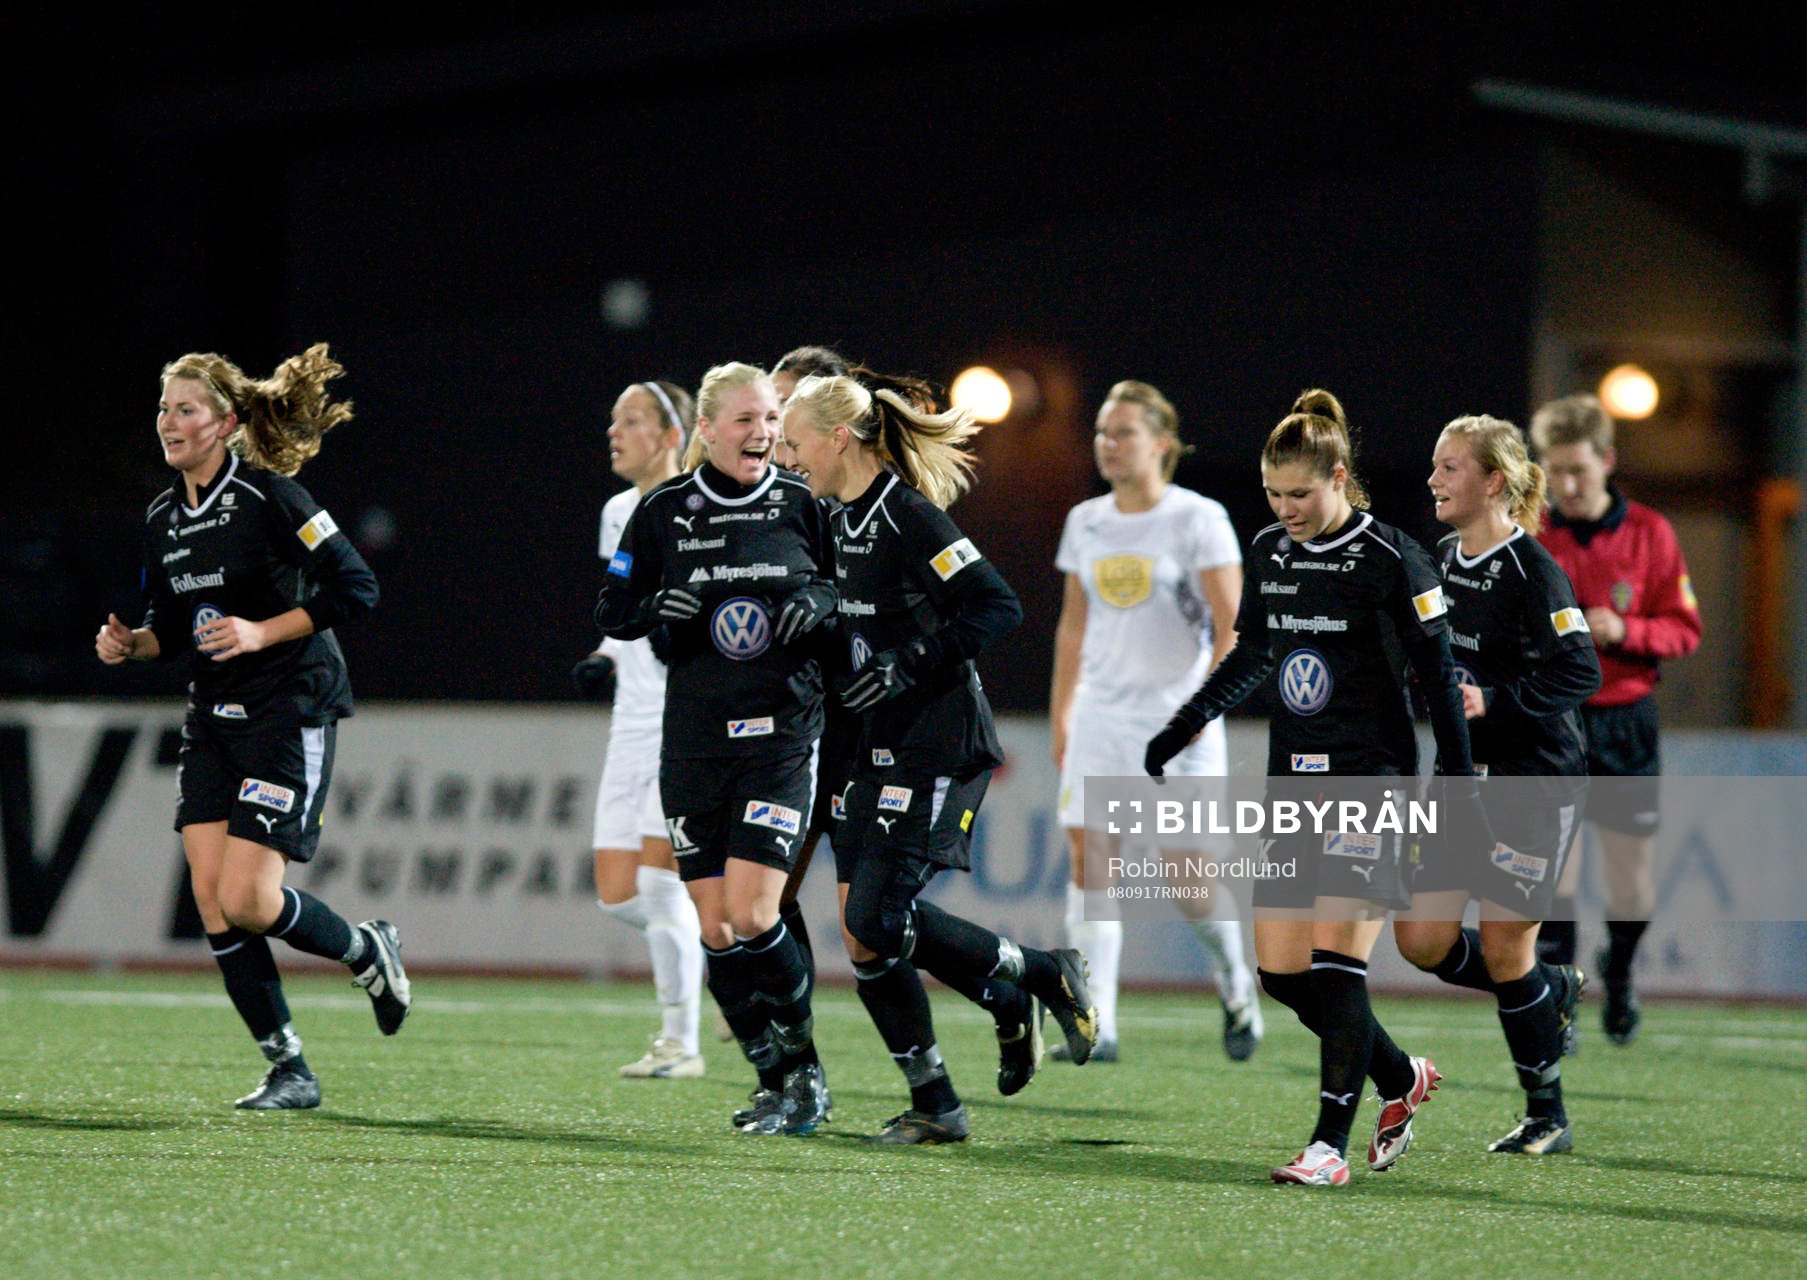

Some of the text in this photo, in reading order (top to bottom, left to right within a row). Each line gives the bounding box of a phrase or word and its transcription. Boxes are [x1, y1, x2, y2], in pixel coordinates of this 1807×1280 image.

[678, 538, 725, 552] Folksam
[712, 563, 788, 582] Myresjöhus
[170, 573, 224, 594] Folksam
[1261, 582, 1297, 594] Folksam
[1281, 614, 1348, 634] Myresjöhus
[1449, 626, 1479, 651] lksam
[260, 783, 289, 798] INTER
[883, 788, 907, 800] NTER
[258, 793, 288, 808] SPORT
[770, 805, 798, 820] INTER
[769, 816, 796, 831] SPORT
[1345, 834, 1377, 846] INTER
[1343, 844, 1376, 856] SPORT
[1513, 853, 1545, 869] INTER
[1511, 864, 1542, 878] SPORT
